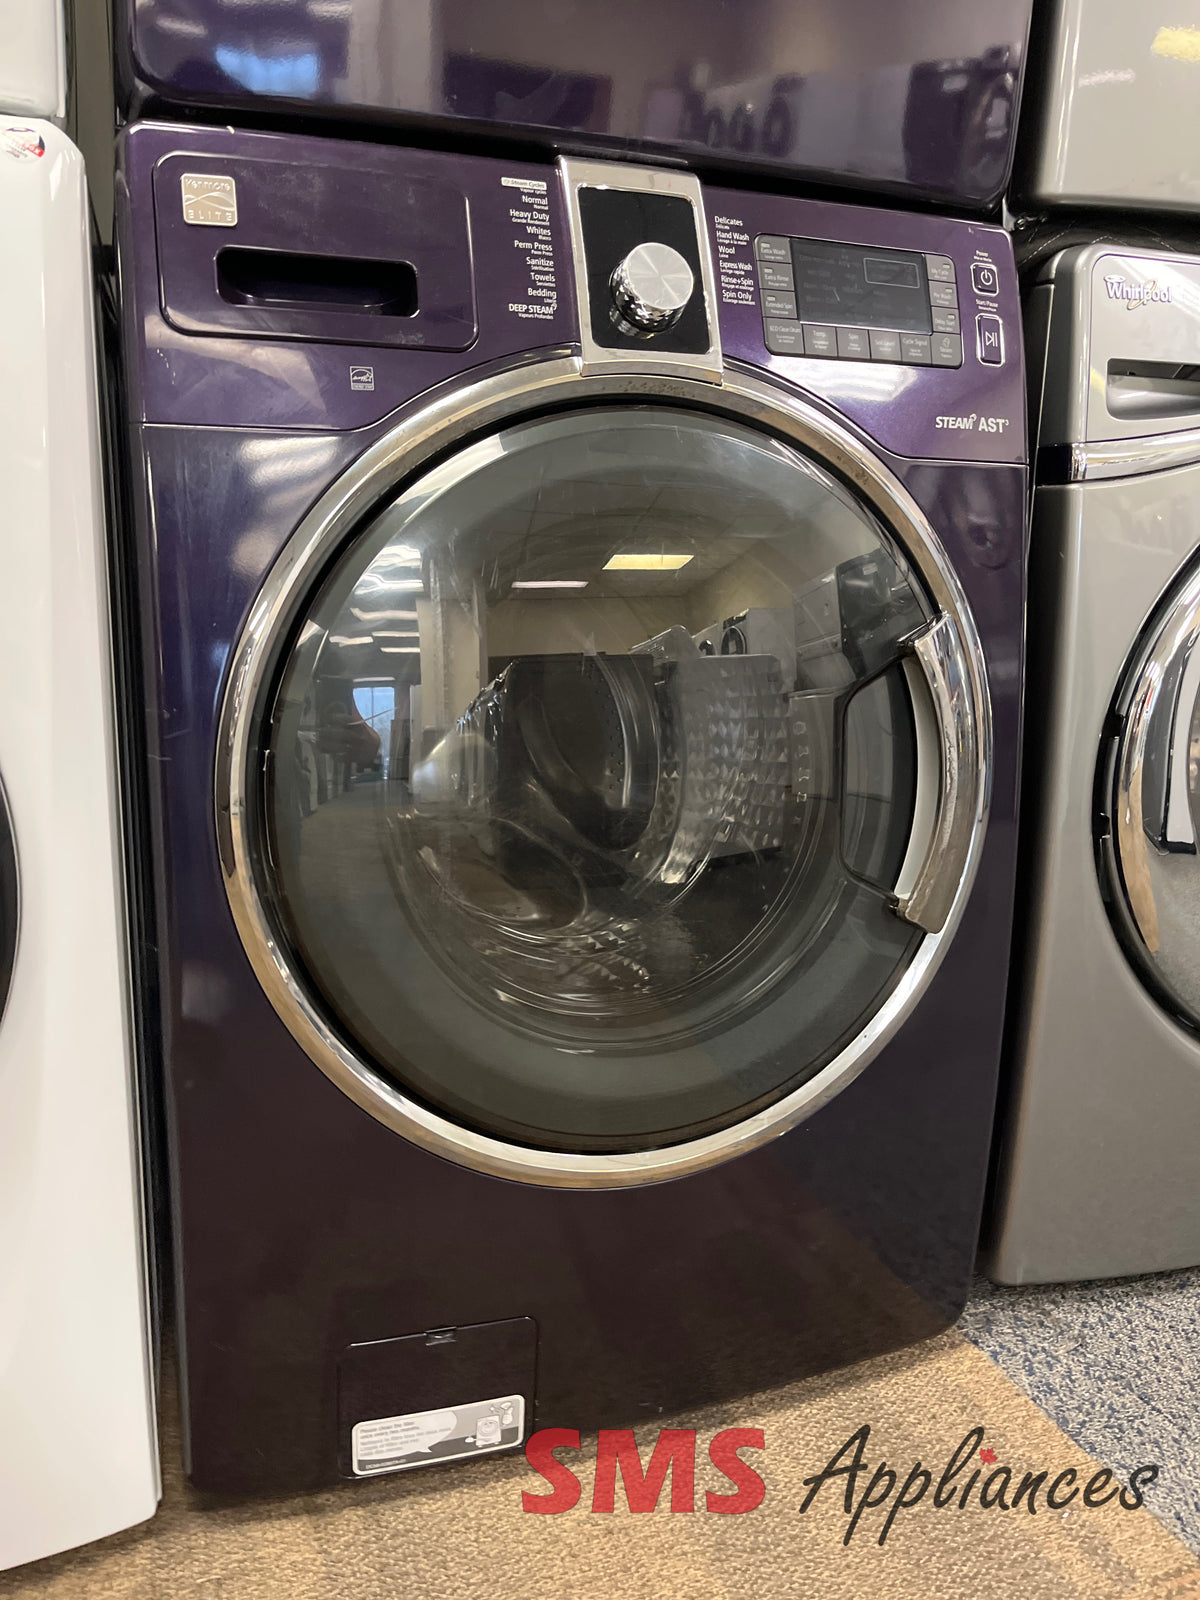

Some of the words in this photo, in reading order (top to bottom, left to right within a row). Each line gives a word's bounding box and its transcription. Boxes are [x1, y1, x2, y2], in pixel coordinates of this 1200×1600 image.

[185, 179, 231, 191] Kenmore
[522, 195, 548, 205] Normal
[188, 210, 232, 221] ELITE
[510, 209, 532, 221] Heavy
[532, 211, 550, 221] Duty
[714, 215, 744, 227] Delicates
[526, 226, 552, 236] Whites
[716, 230, 733, 239] Hand
[732, 231, 750, 241] Wash
[514, 240, 533, 249] Perm
[534, 242, 553, 252] Press
[718, 245, 736, 255] Wool
[526, 256, 555, 267] Sanitize
[738, 262, 753, 271] Wash
[530, 272, 556, 282] Towels
[527, 287, 557, 300] Bedding
[722, 289, 737, 299] Spin
[737, 291, 752, 301] Only
[1104, 275, 1173, 306] Whirlpool
[508, 303, 527, 312] DEEP
